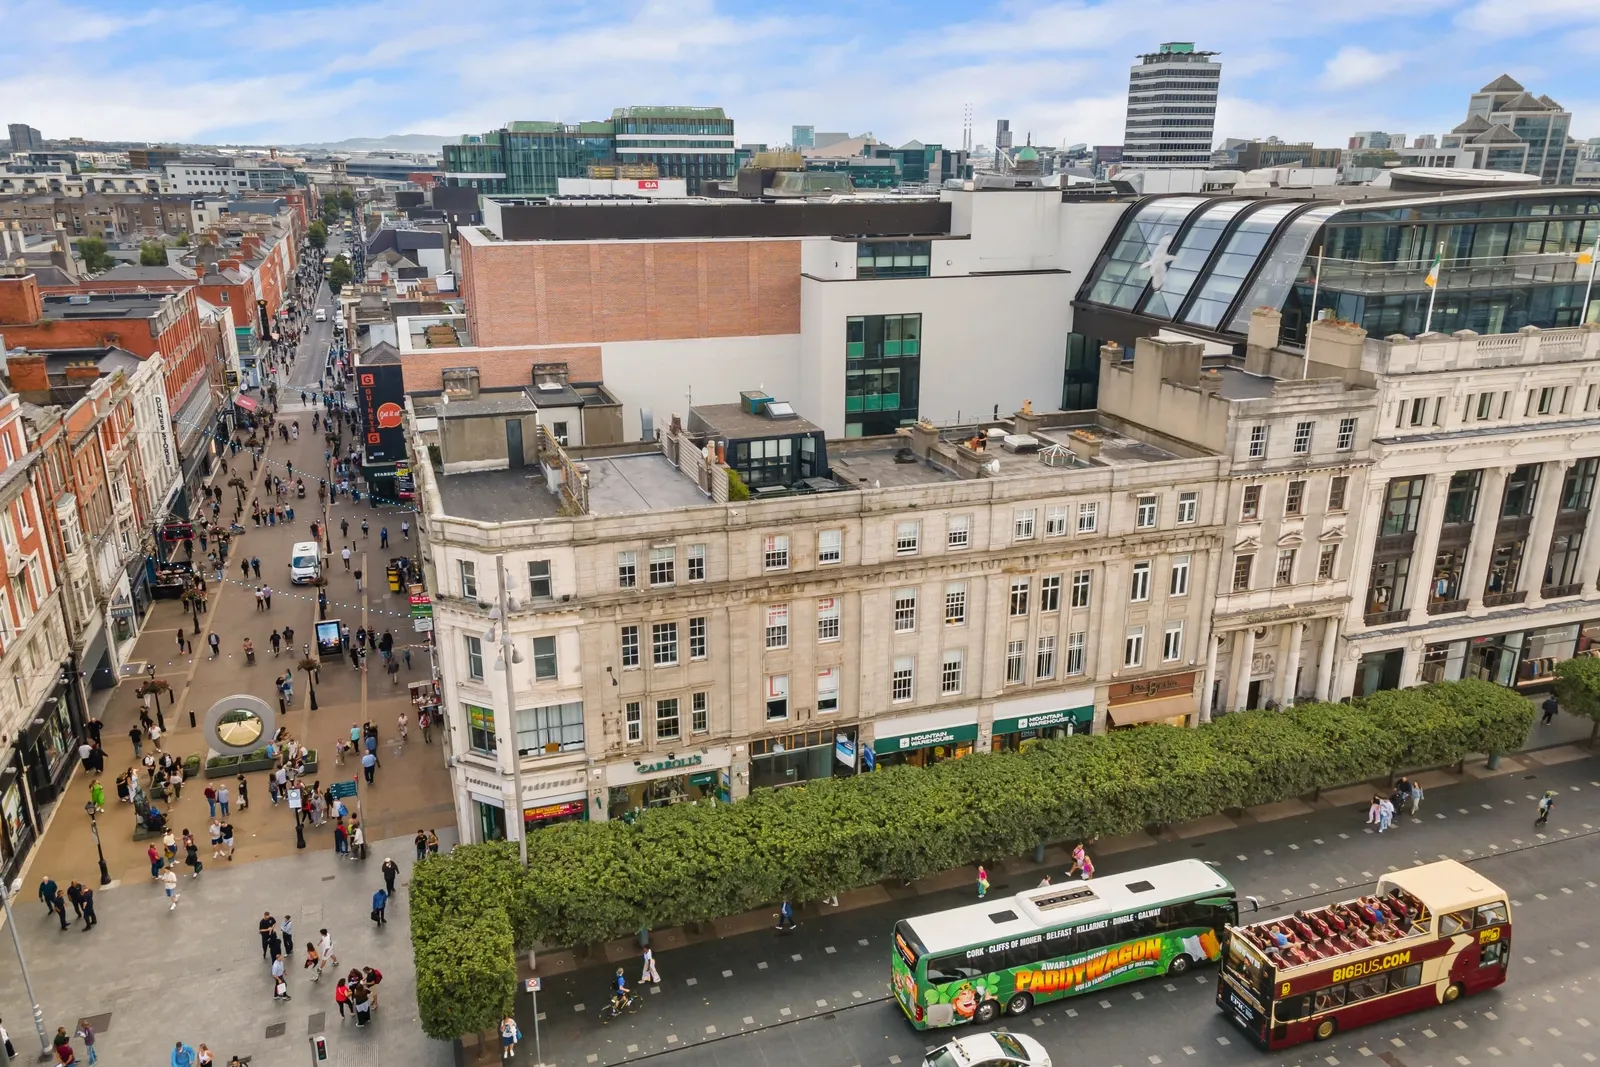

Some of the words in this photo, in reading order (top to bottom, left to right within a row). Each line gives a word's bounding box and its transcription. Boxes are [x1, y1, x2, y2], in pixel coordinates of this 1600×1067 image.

[365, 389, 376, 432] GUINEYS
[155, 397, 164, 430] DUNNES
[162, 432, 170, 466] STORES
[1302, 610, 1316, 618] Spa
[1029, 713, 1064, 722] MOUNTAIN
[1029, 716, 1070, 727] WAREHOUSE
[911, 731, 947, 741] MOUNTAIN
[911, 735, 954, 746] WAREHOUSE
[637, 755, 702, 774] CARROLL'S
[966, 948, 984, 958] CORK
[989, 941, 1010, 953] CLIFFS
[1011, 939, 1019, 948] OF
[1020, 935, 1042, 947] MOHER
[1046, 928, 1072, 940] BELFAST
[1076, 920, 1109, 933] KILLARNEY
[1113, 914, 1134, 925] DINGLE
[1138, 908, 1161, 920] GALWAY
[1041, 959, 1069, 970] AWARD
[1072, 949, 1107, 966] WINNING
[1332, 951, 1411, 982] BIGBUS.COM
[1075, 980, 1091, 992] WORLD
[1092, 972, 1112, 986] FAMOUS
[1112, 966, 1127, 978] TOURS
[1128, 964, 1135, 972] OF
[1135, 960, 1154, 969] IRELAND
